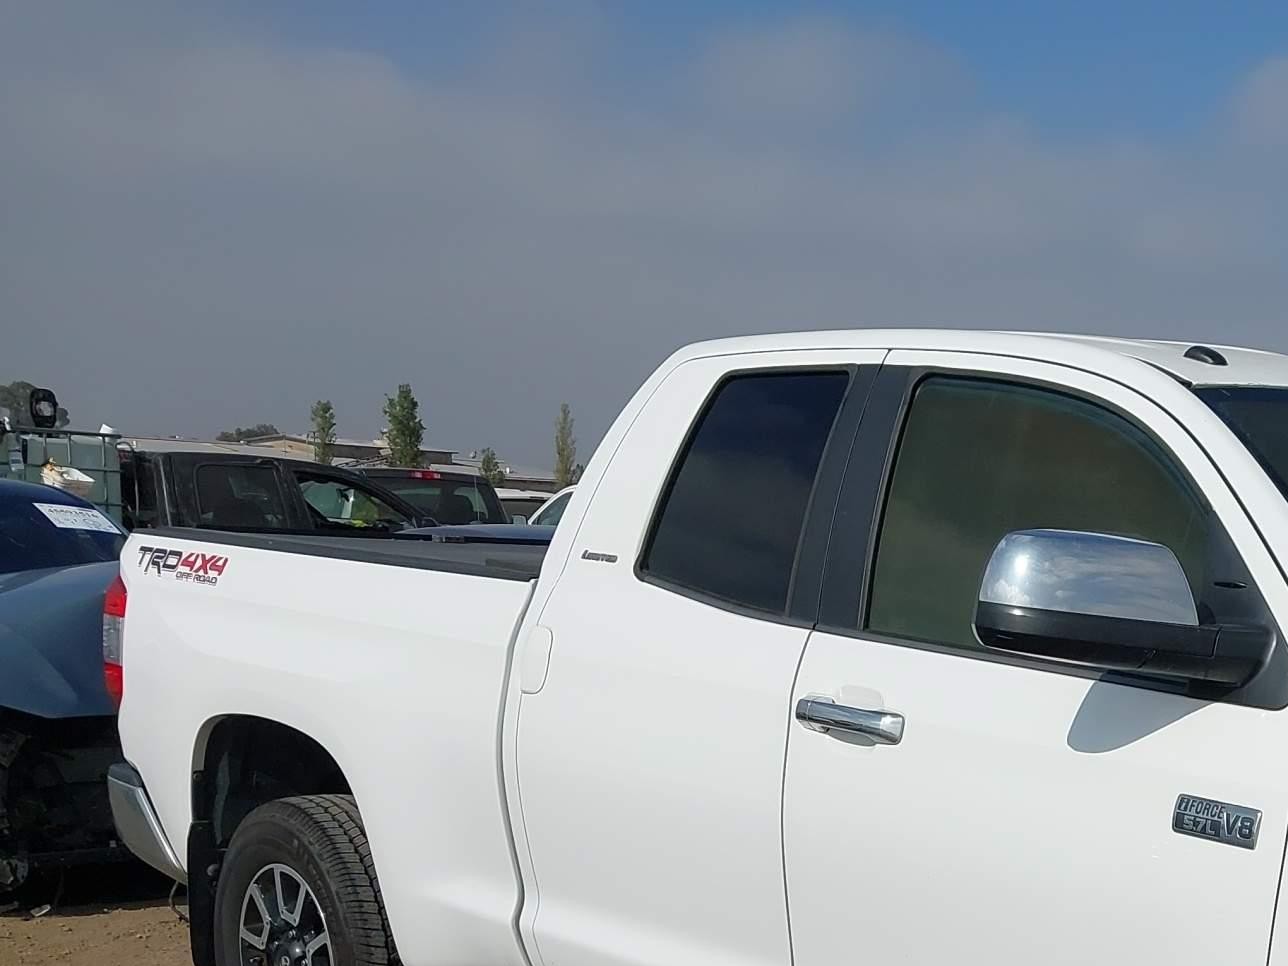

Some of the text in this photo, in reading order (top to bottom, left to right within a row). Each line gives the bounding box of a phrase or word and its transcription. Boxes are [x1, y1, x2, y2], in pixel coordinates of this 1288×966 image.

[175, 571, 218, 586] OFF ROAD
[1223, 811, 1255, 840] V8
